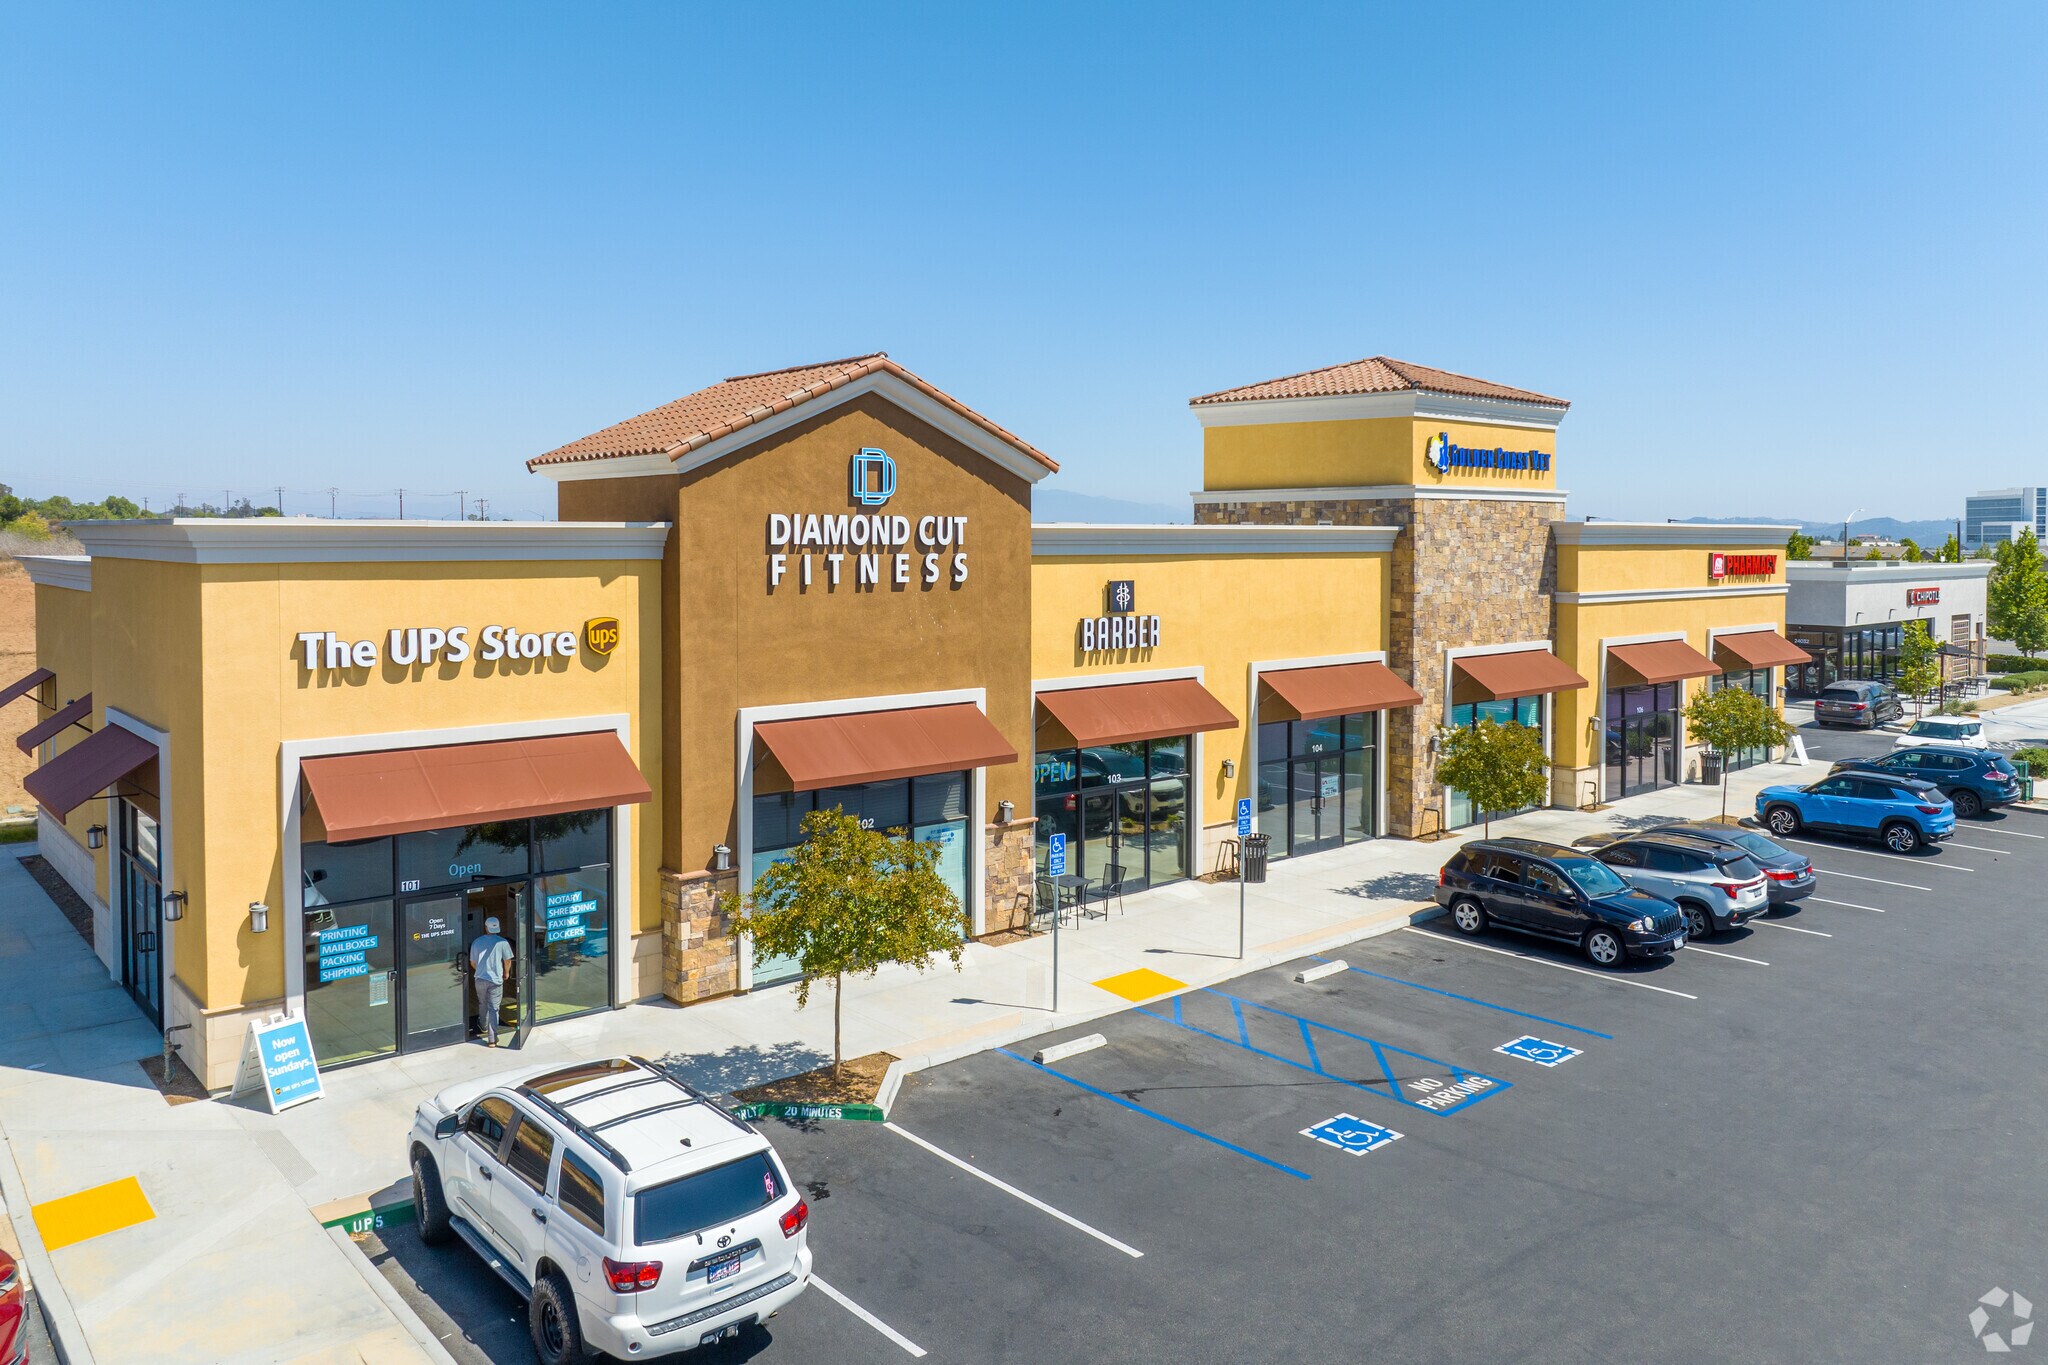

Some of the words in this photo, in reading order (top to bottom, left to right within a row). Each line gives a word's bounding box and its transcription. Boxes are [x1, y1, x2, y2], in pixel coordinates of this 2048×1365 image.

[1451, 444, 1494, 468] GOLDEN
[1497, 447, 1530, 470] COAST
[1533, 450, 1551, 471] VET
[770, 513, 910, 546] DIAMOND
[919, 516, 968, 546] CUT
[771, 553, 968, 585] FITNESS
[1727, 554, 1778, 576] PHARMACY
[590, 627, 617, 651] ups
[1083, 615, 1160, 651] BARBER
[298, 631, 377, 669] The
[390, 626, 469, 665] UPS
[482, 625, 578, 661] Store
[1312, 744, 1323, 753] 104
[1107, 773, 1122, 784] 103
[449, 863, 481, 878] Open
[402, 880, 419, 891] 101
[548, 893, 580, 905] NOTARY
[549, 902, 595, 917] SHREDDING
[549, 916, 579, 928] FAXING
[321, 928, 366, 941] PRINTING
[549, 928, 584, 940] LOCKERS
[322, 938, 376, 955] MAILBOXES
[322, 953, 364, 967] PACKING
[323, 965, 367, 980] SHIPPING
[272, 1036, 296, 1049] Now
[274, 1048, 300, 1062] open
[267, 1058, 312, 1078] Sundays.
[1408, 1078, 1443, 1093] NO
[1416, 1076, 1492, 1110] PARKING
[784, 1106, 798, 1116] 20
[801, 1106, 842, 1118] MINUTES
[353, 1216, 383, 1232] UPS
